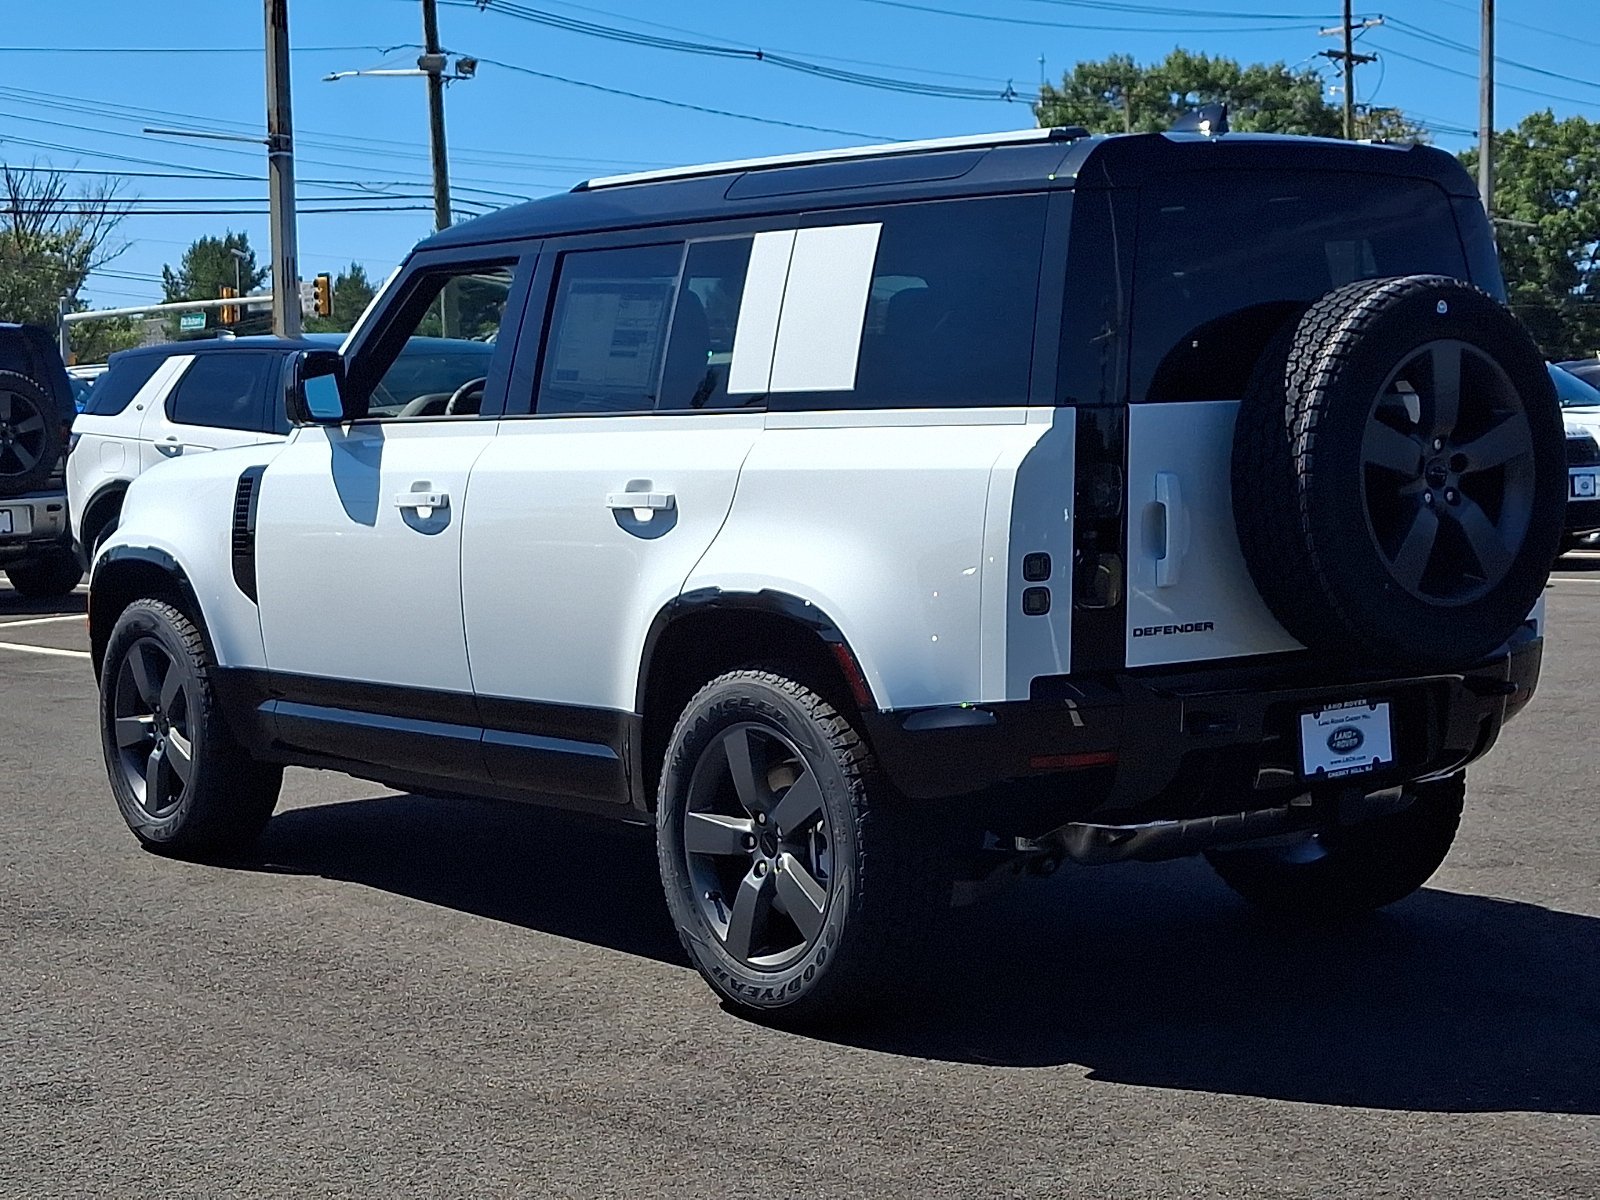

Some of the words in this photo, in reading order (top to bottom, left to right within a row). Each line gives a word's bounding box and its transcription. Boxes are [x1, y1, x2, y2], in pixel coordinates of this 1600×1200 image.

[1132, 621, 1214, 638] DEFENDER
[1323, 703, 1342, 711] LAND
[1343, 699, 1367, 708] ROVER
[1334, 730, 1352, 740] LAND
[1336, 738, 1358, 748] ROVER
[1327, 770, 1349, 779] CHERRY
